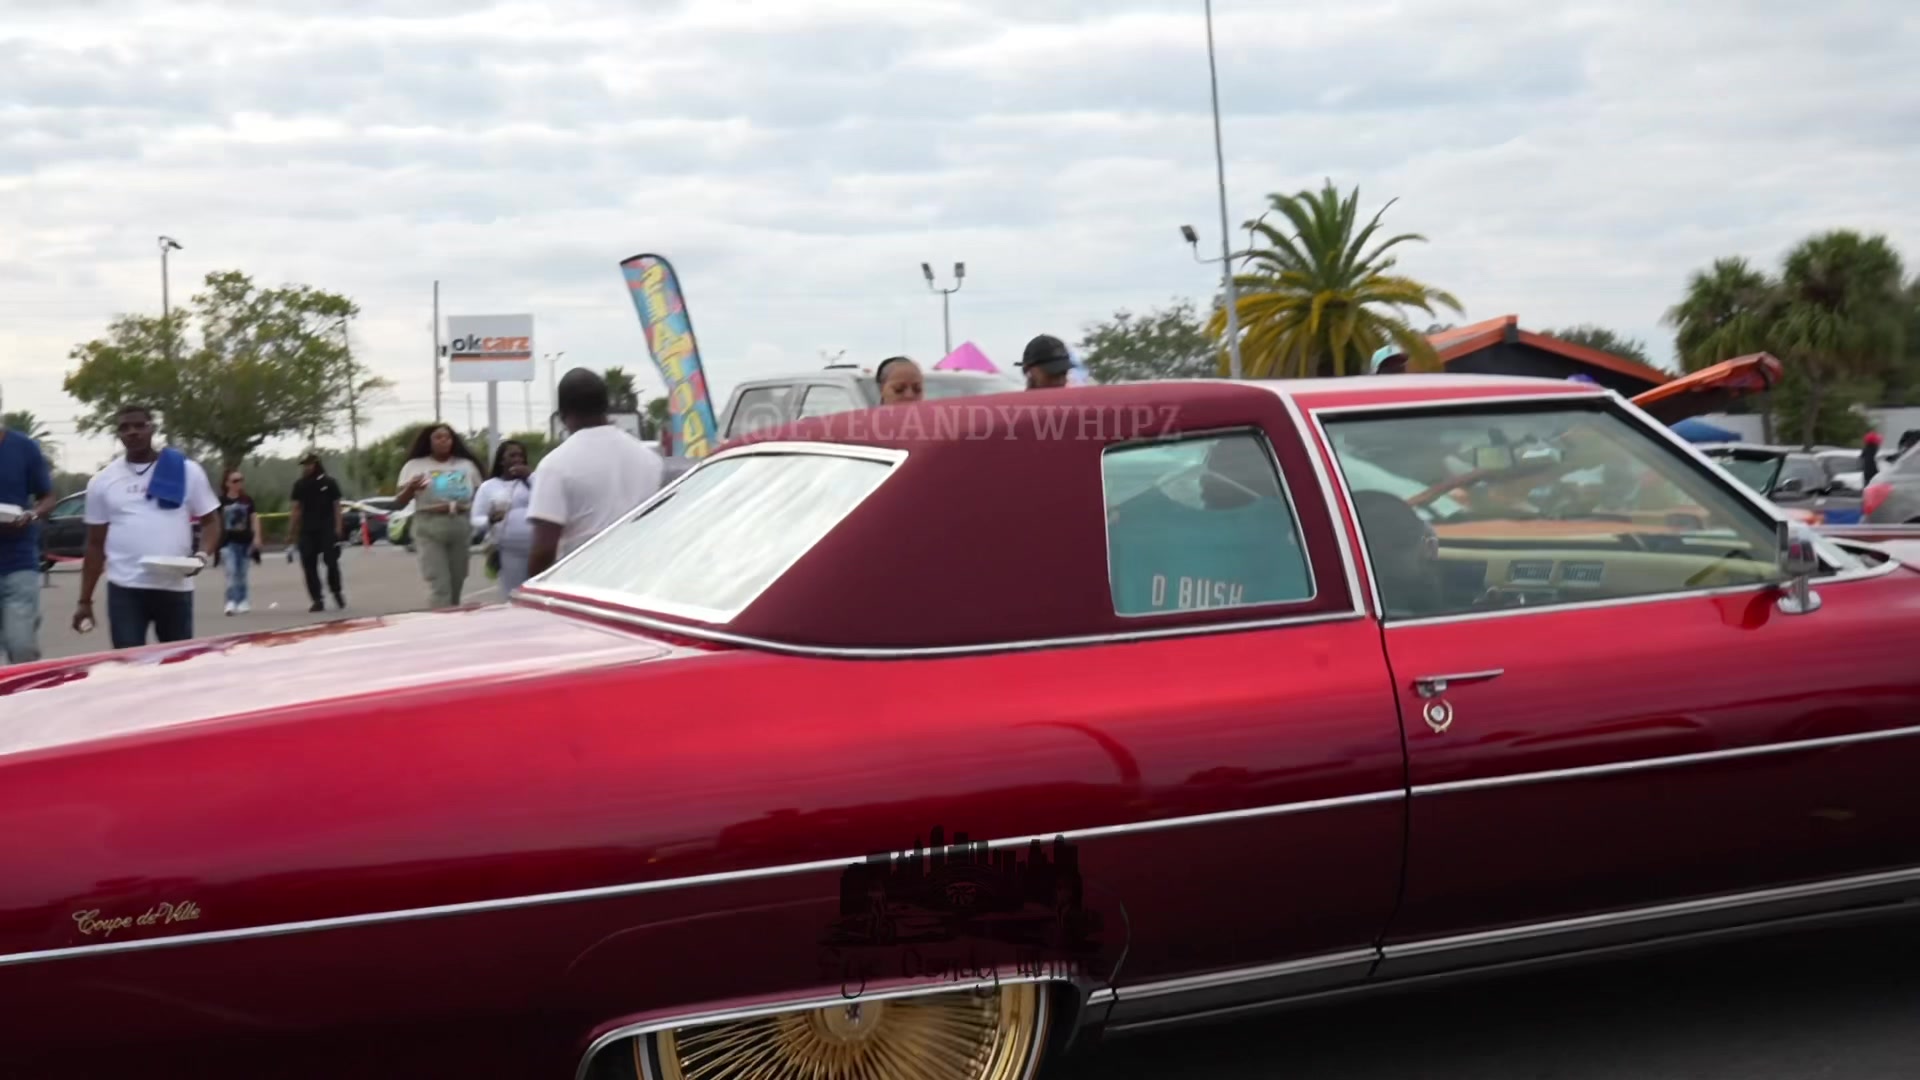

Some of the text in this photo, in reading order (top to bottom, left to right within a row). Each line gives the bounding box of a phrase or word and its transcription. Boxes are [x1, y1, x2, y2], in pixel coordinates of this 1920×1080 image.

[452, 333, 530, 352] okcarz
[1151, 574, 1244, 609] D BUSH
[71, 908, 133, 937] Coupe
[156, 900, 202, 924] Ville
